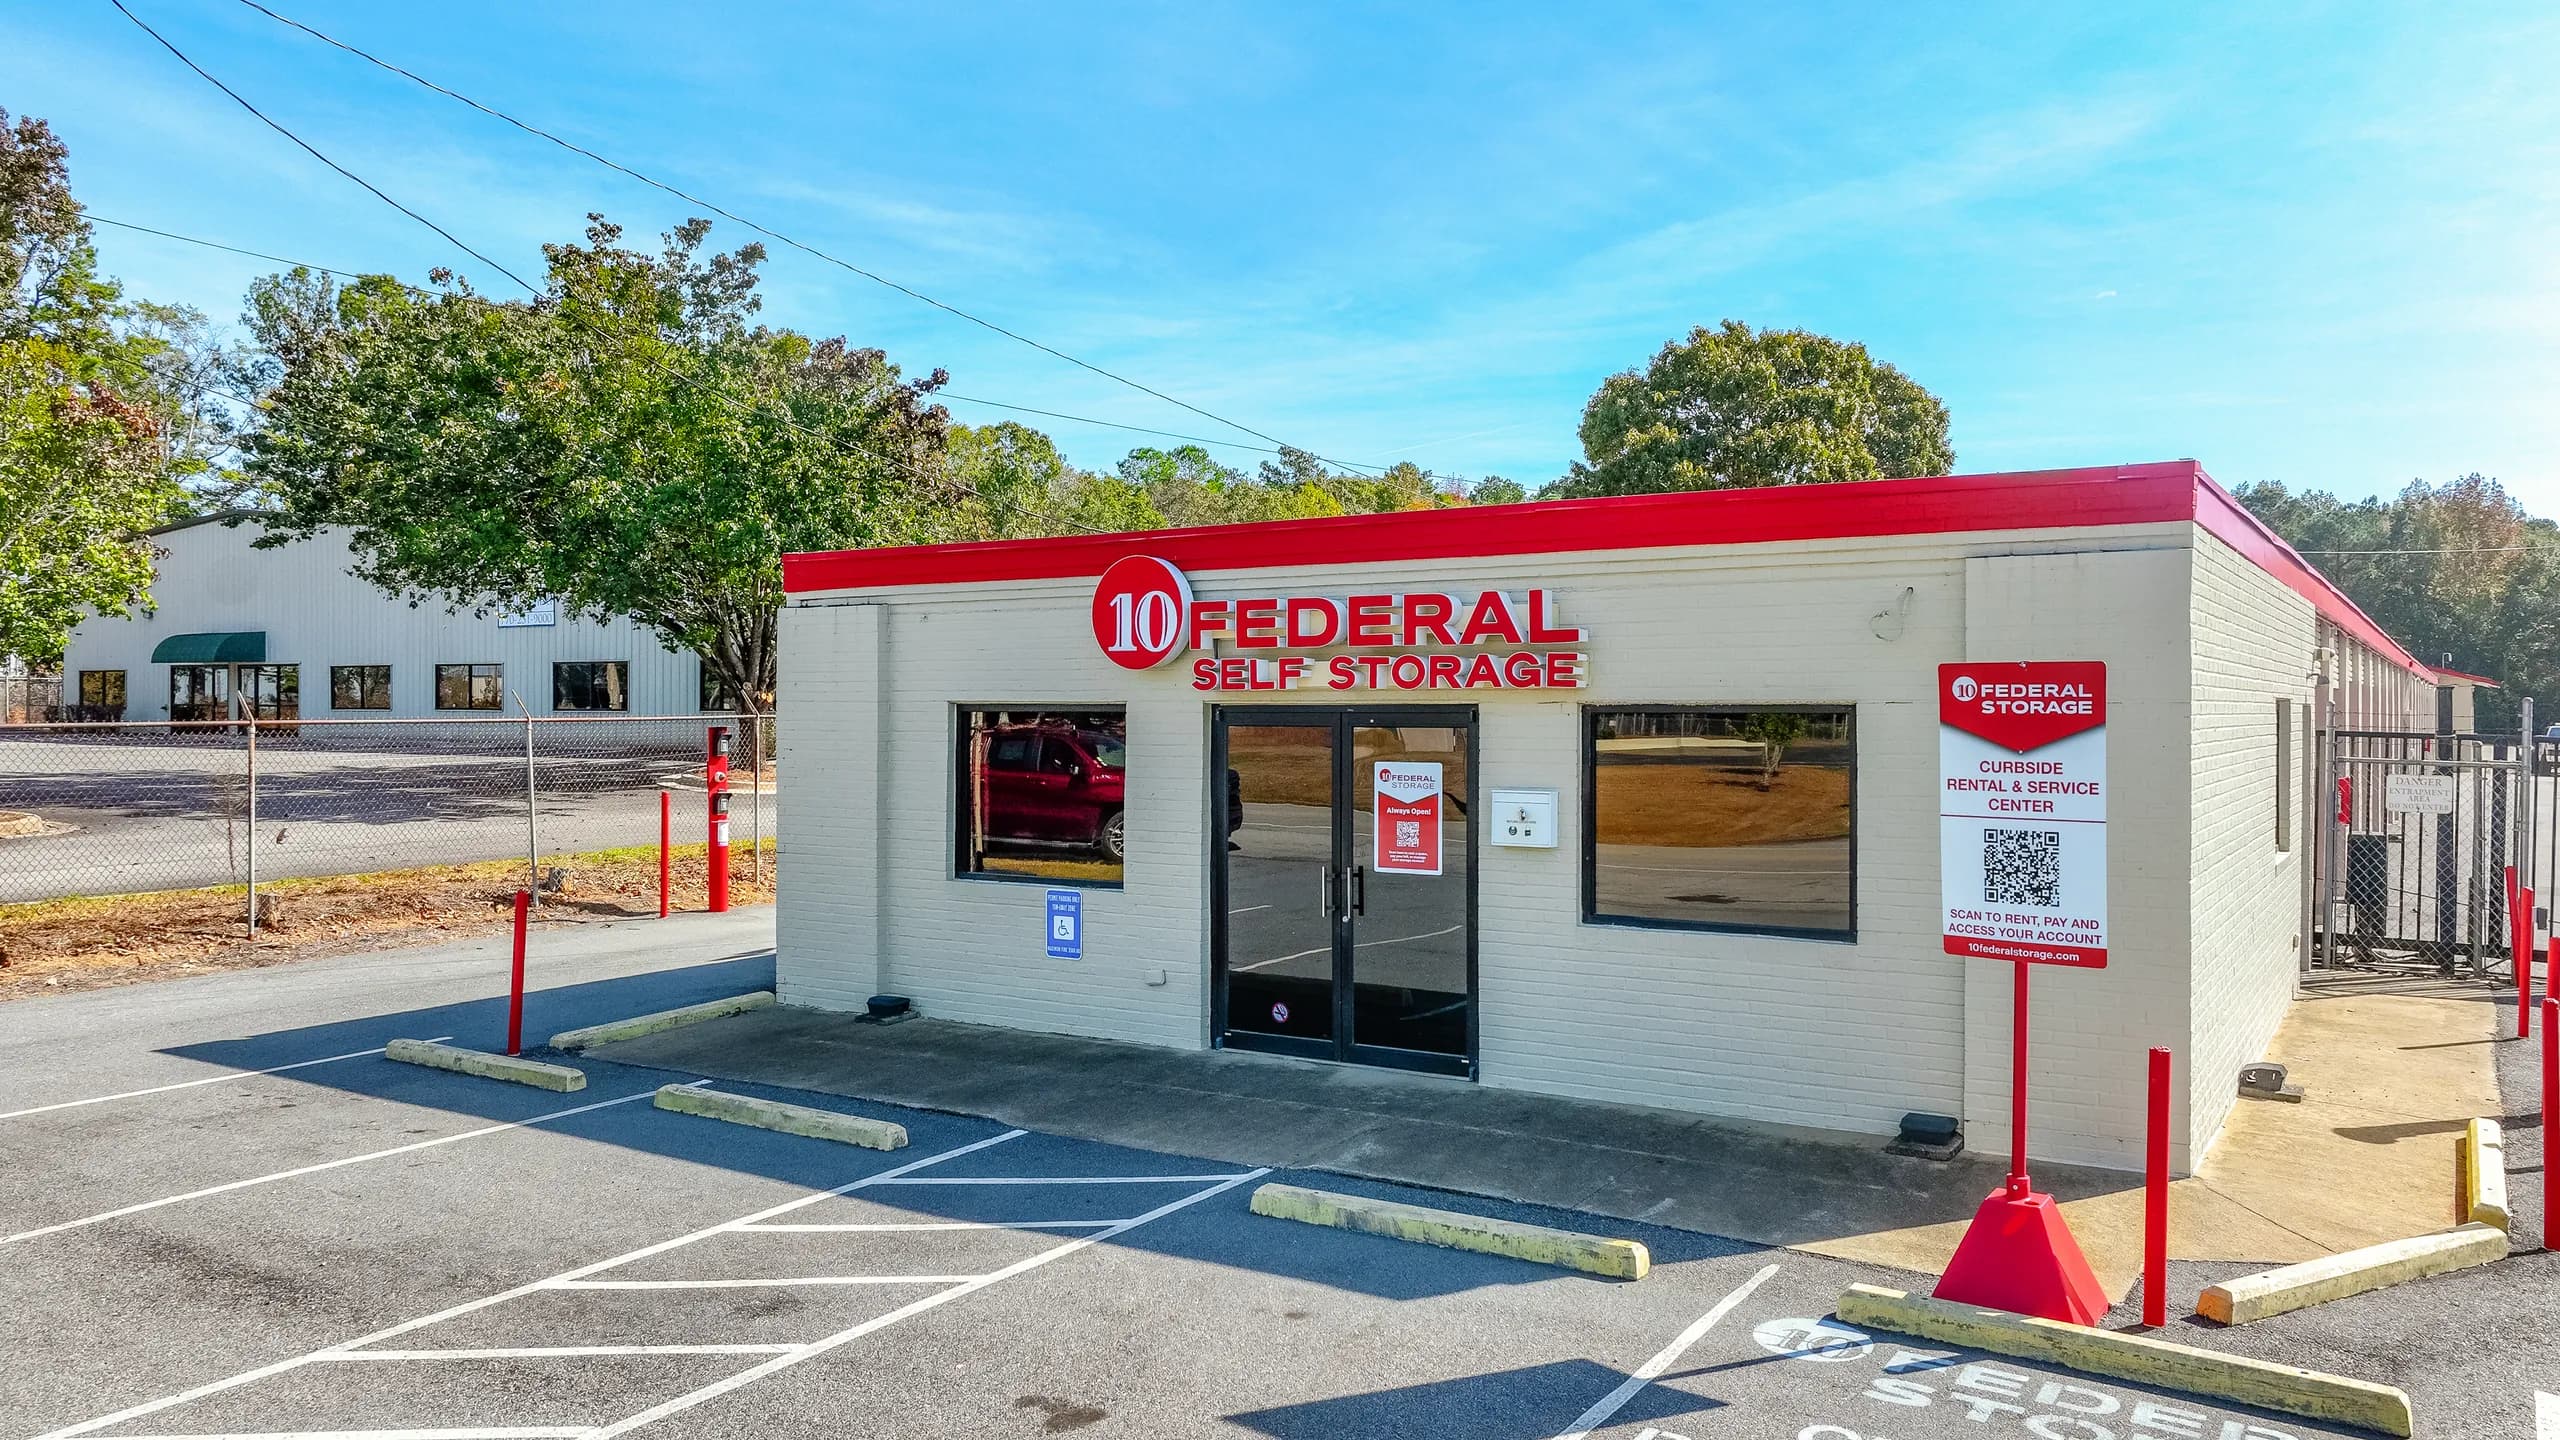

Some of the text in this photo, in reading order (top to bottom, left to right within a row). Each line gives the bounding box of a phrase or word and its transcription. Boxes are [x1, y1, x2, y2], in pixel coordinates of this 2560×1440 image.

[1108, 589, 1581, 653] 10 FEDERAL
[1191, 652, 1580, 691] SELF STORAGE
[1957, 683, 2092, 698] 10 FEDERAL
[1981, 701, 2092, 714] STORAGE
[1979, 760, 2063, 775] CURBSIDE
[1391, 774, 1436, 783] FEDERAL
[1391, 782, 1435, 790] STORAGE
[2396, 777, 2442, 786] DANGER
[1947, 778, 2099, 795] RENTAL & SERVICE
[2389, 787, 2449, 796] ENTRAPMENT
[1386, 807, 1431, 816] Always Open!
[1988, 798, 2053, 813] CENTER
[1950, 909, 2099, 930] SCAN TO RENT, PAY AND
[1949, 923, 2102, 945] ACCESS YOUR ACCOUNT
[1968, 943, 2080, 961] 10federalstorage.com
